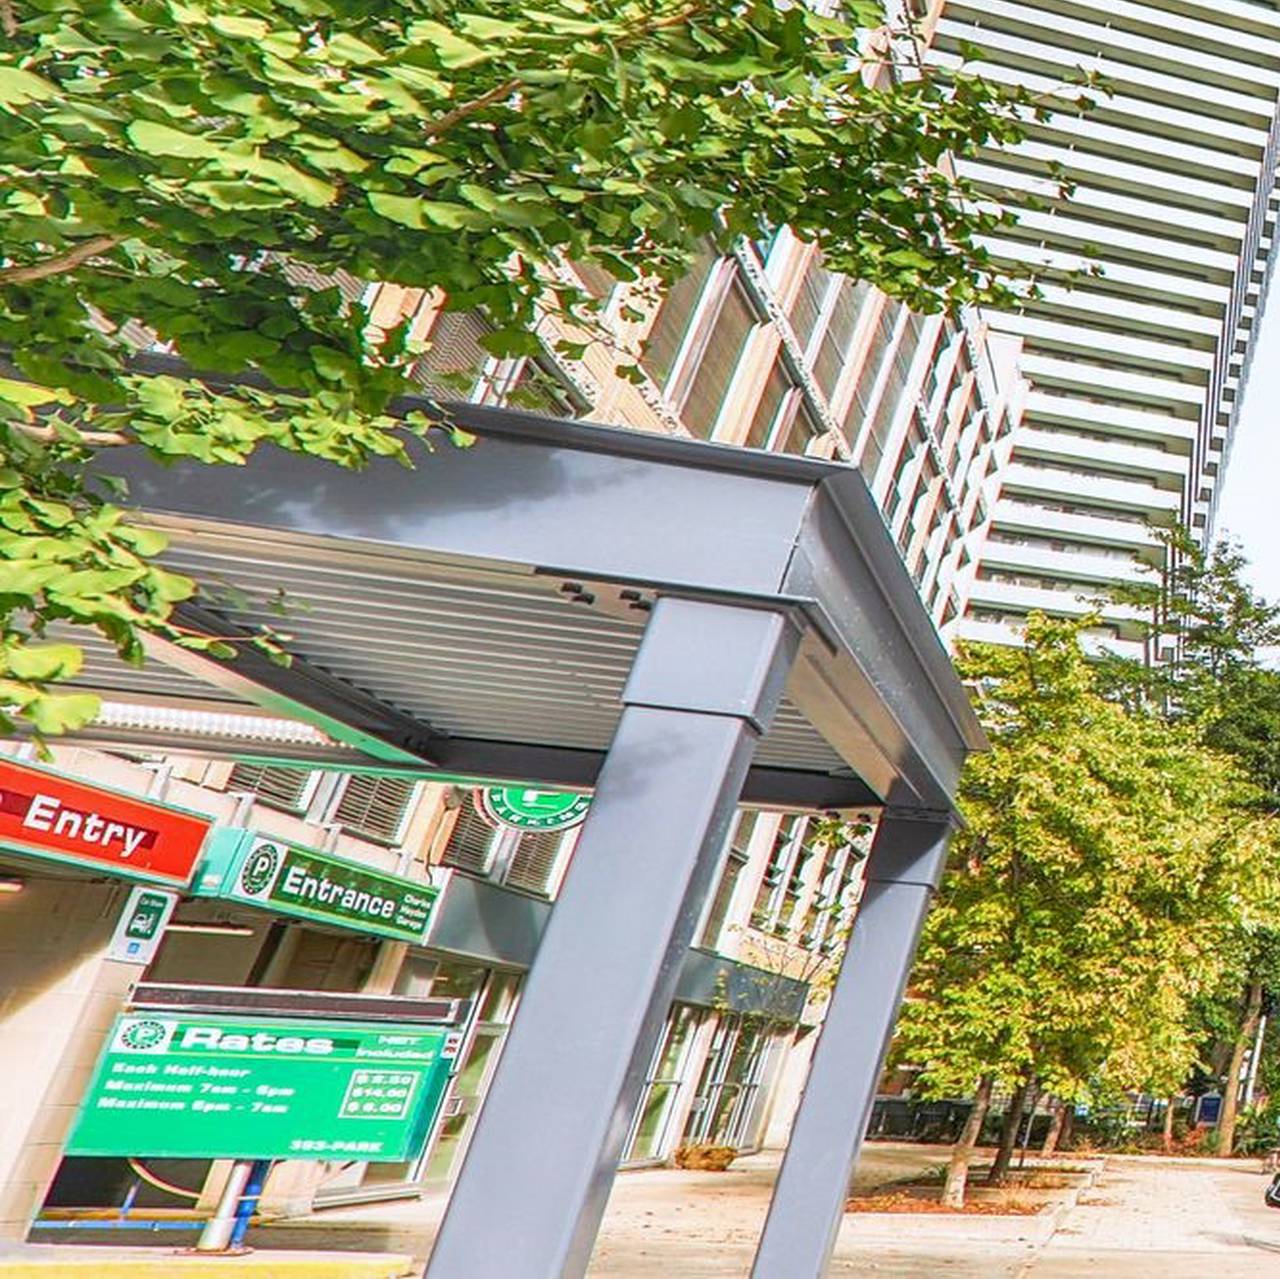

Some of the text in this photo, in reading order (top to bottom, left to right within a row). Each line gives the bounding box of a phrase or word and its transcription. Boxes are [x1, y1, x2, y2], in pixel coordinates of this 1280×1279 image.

[23, 793, 147, 858] Entry
[282, 866, 396, 918] Entrance
[180, 1026, 335, 1055] Rates
[104, 1080, 193, 1093] Maximum
[200, 1082, 238, 1095] 7am
[97, 1096, 186, 1110] Maximum
[251, 1102, 289, 1114] 7am
